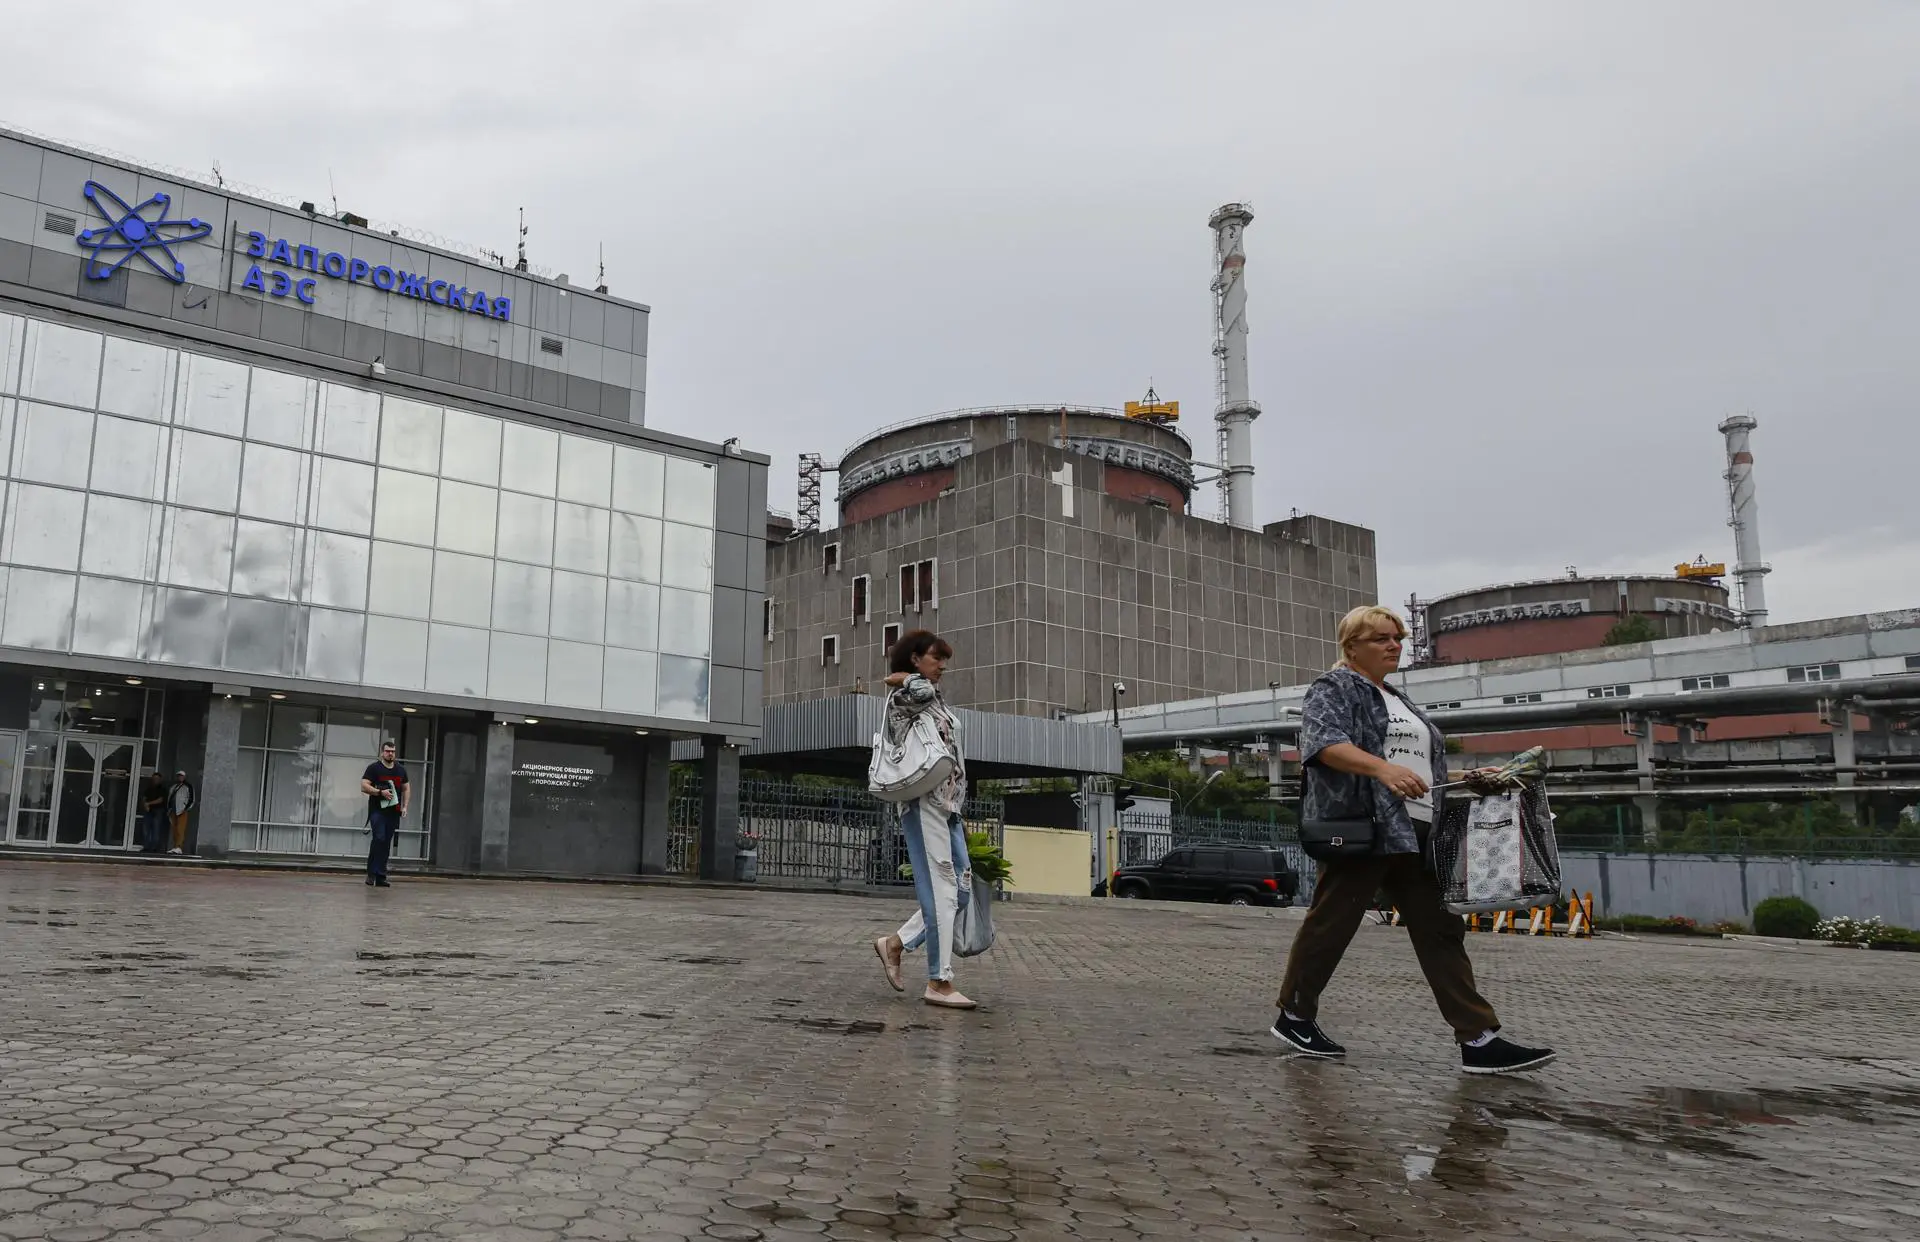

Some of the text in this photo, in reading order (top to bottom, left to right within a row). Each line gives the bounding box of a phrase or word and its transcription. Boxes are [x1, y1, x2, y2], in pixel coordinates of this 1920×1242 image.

[242, 264, 317, 304] АЭС
[247, 230, 511, 321] ЗАПОРОЖСКАЯ
[1388, 747, 1411, 759] you
[522, 763, 594, 774] АКЦИОНЕРНОЕ ОБЩЕСТВО
